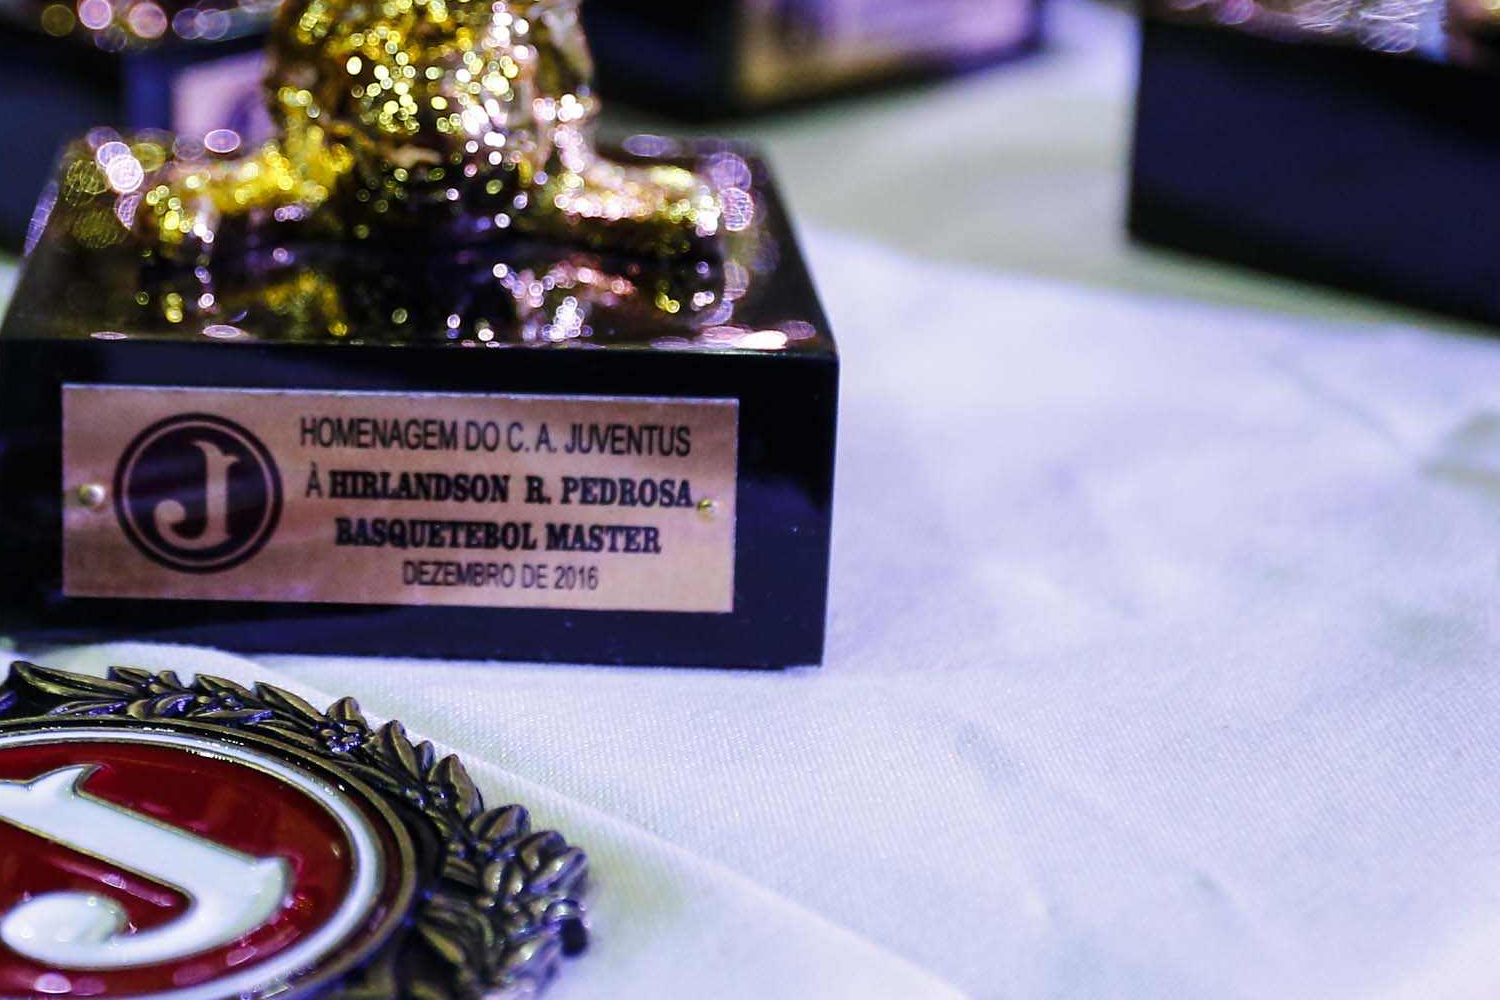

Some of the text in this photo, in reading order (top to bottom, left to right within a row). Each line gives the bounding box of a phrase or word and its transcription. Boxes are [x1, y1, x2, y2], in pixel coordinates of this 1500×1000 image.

[300, 416, 458, 451] HOMENAGEM
[464, 421, 500, 452] DO
[565, 423, 692, 457] JUVENTUS
[329, 468, 511, 504] HIRLANDSON
[525, 475, 551, 504] R.
[560, 476, 694, 508] PEDROSA
[335, 517, 662, 554] BASQUETEBOL MASTER
[403, 559, 599, 591] DEZEMBRO DE 2016
